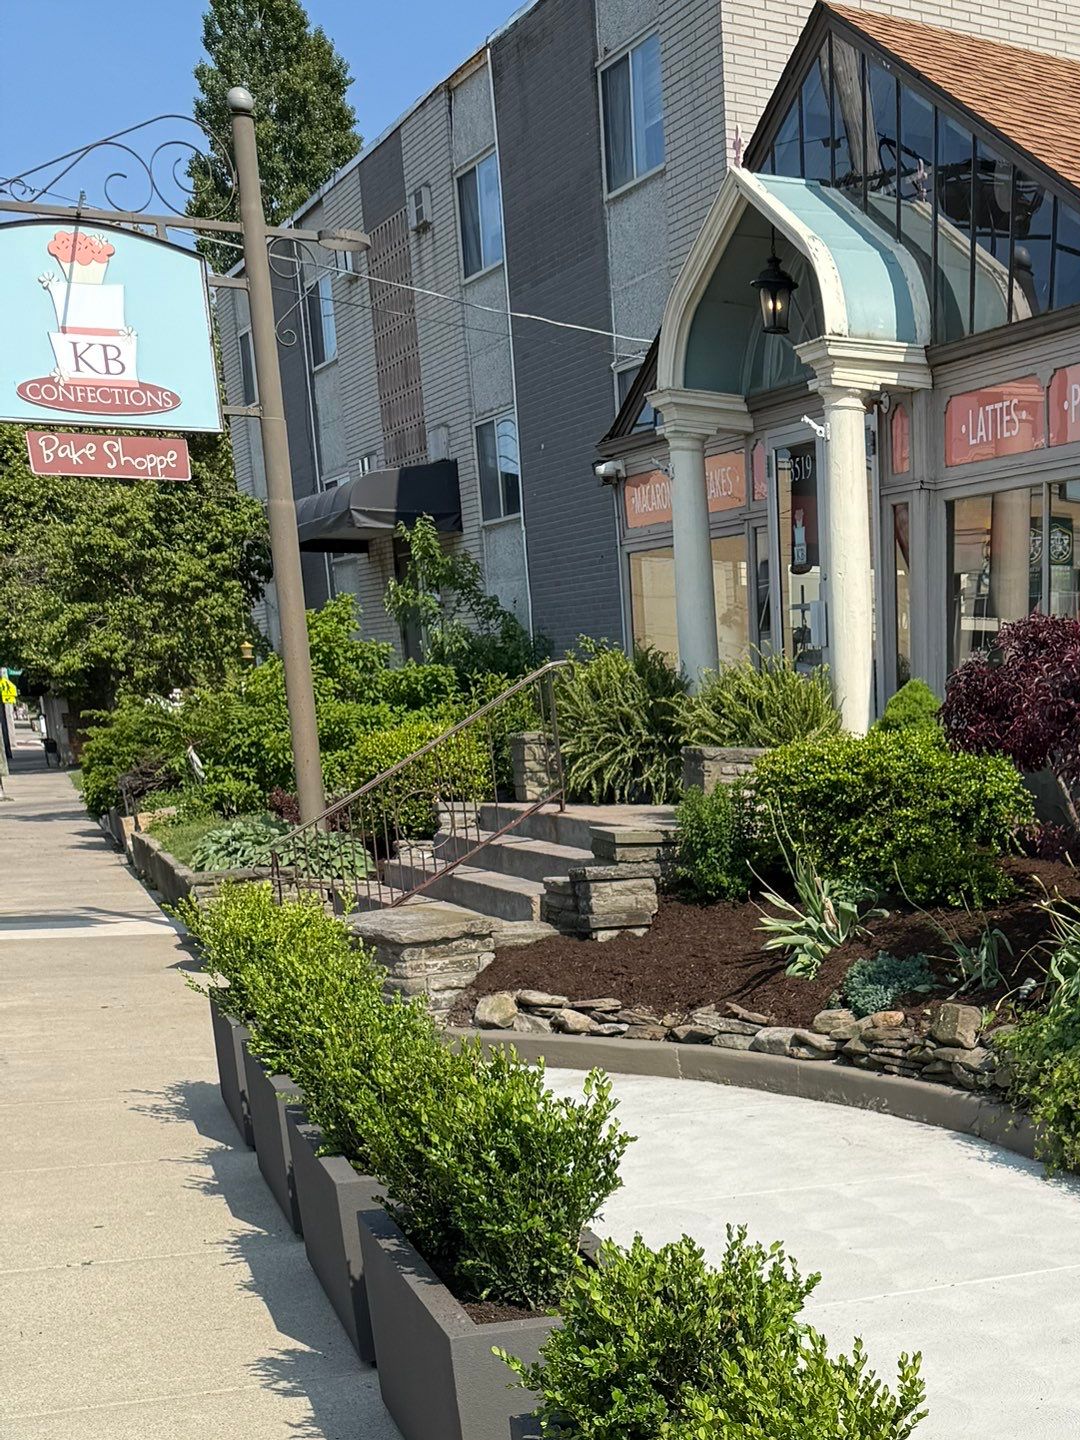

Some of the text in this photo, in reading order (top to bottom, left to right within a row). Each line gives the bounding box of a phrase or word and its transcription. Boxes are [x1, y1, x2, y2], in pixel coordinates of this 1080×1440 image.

[70, 341, 126, 375] KB
[26, 383, 173, 408] CONFECTIONS
[968, 399, 1020, 445] LATTES
[38, 435, 178, 477] Bake Shoppe
[706, 466, 733, 499] AKES
